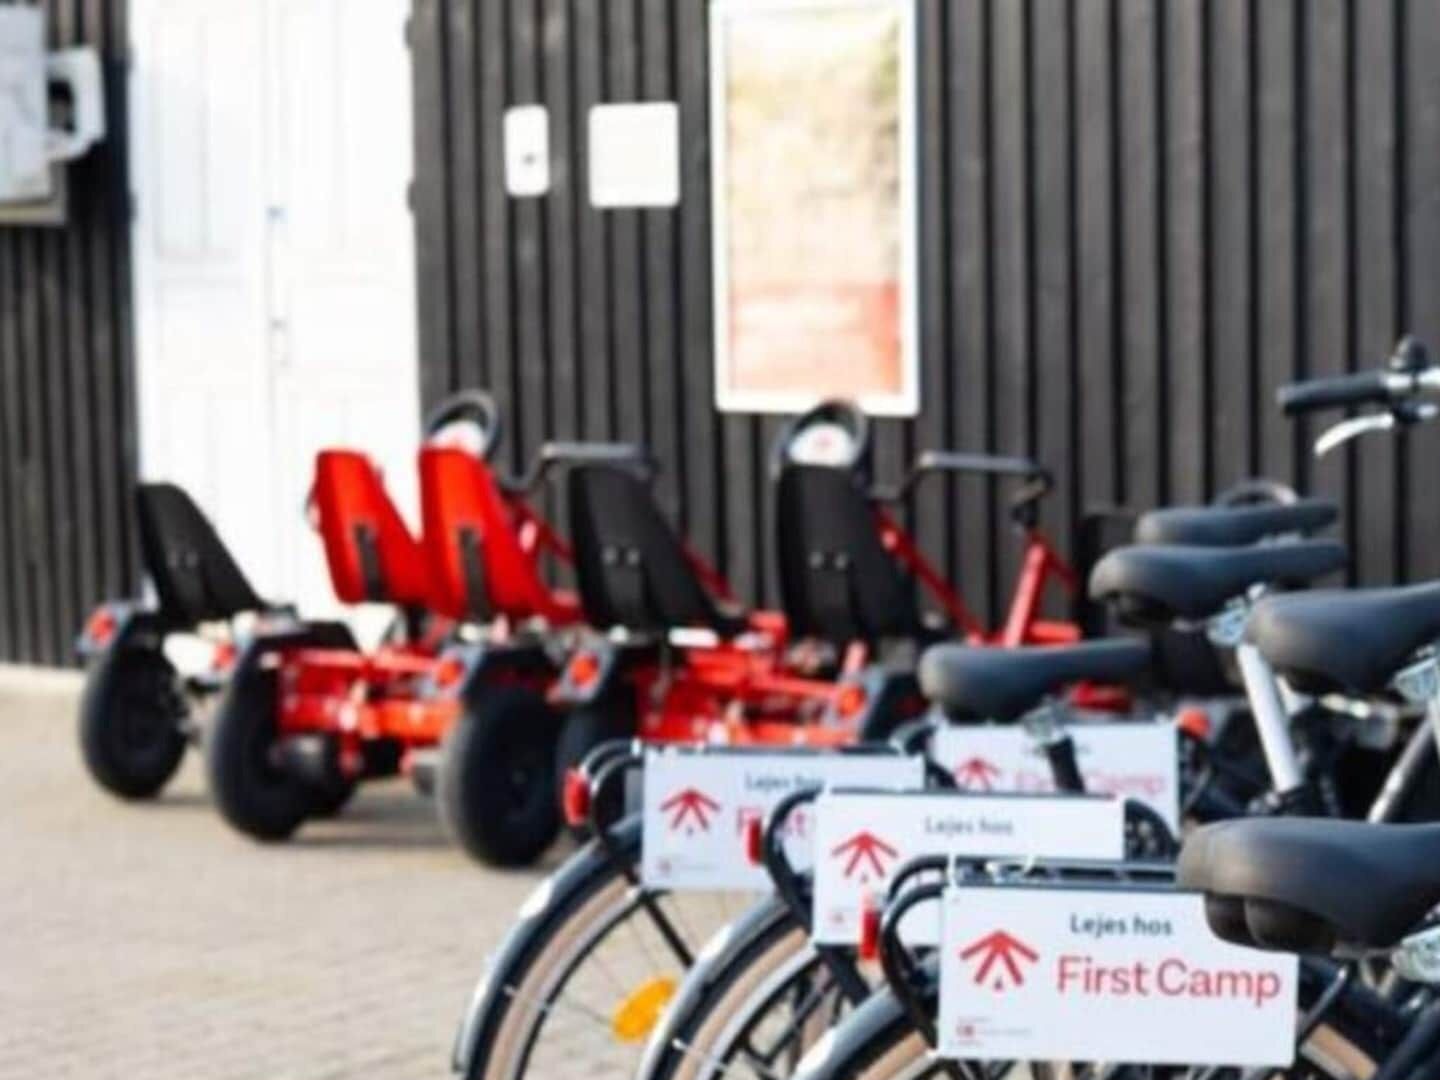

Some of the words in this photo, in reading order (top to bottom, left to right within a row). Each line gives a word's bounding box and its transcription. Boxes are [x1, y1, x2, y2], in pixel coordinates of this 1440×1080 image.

[924, 814, 974, 839] Lejes
[979, 813, 1014, 836] hos
[1069, 913, 1127, 938] Lejes
[1133, 916, 1173, 936] hos
[1056, 955, 1151, 995] First
[1156, 957, 1281, 1006] Camp
